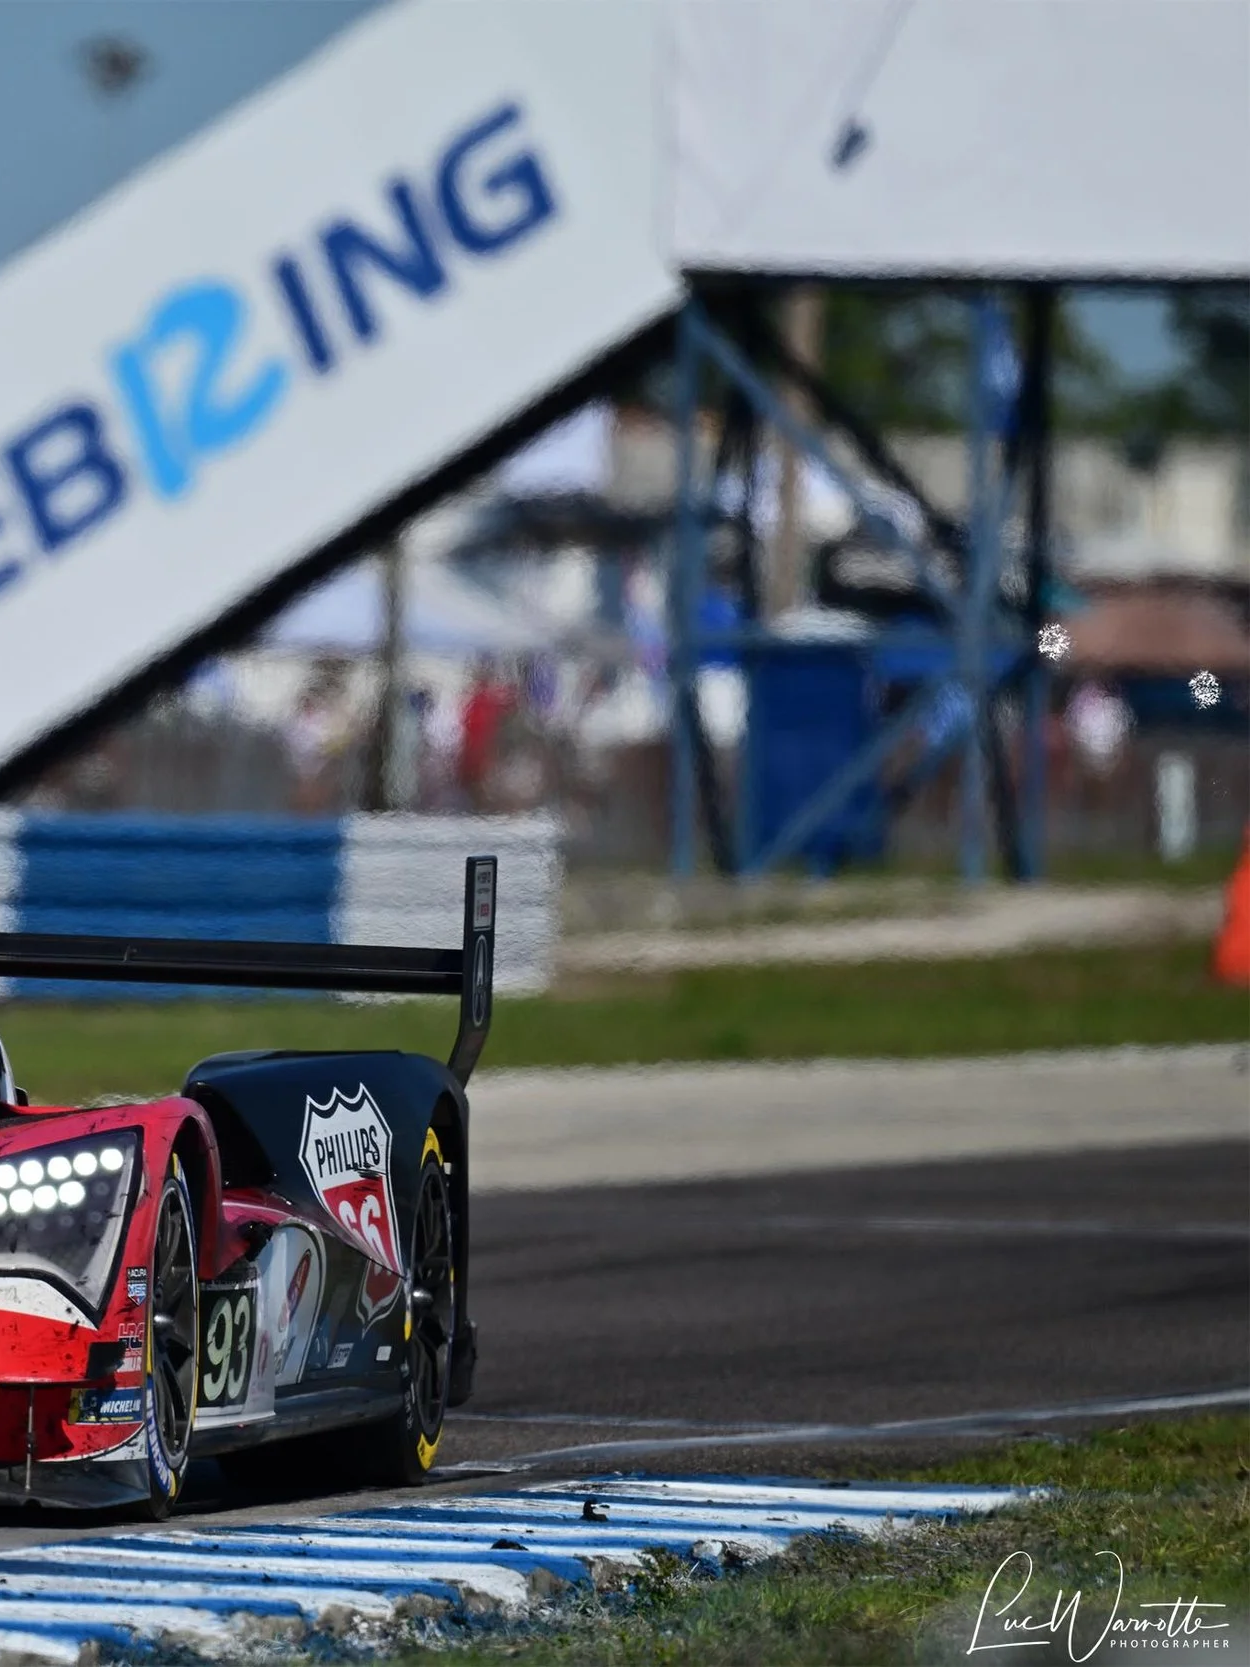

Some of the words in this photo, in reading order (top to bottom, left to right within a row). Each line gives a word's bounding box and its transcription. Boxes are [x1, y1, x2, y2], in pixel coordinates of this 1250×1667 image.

[315, 1125, 380, 1178] PHILLIPS
[204, 1296, 251, 1401] 93
[100, 1400, 142, 1413] MICHELIN
